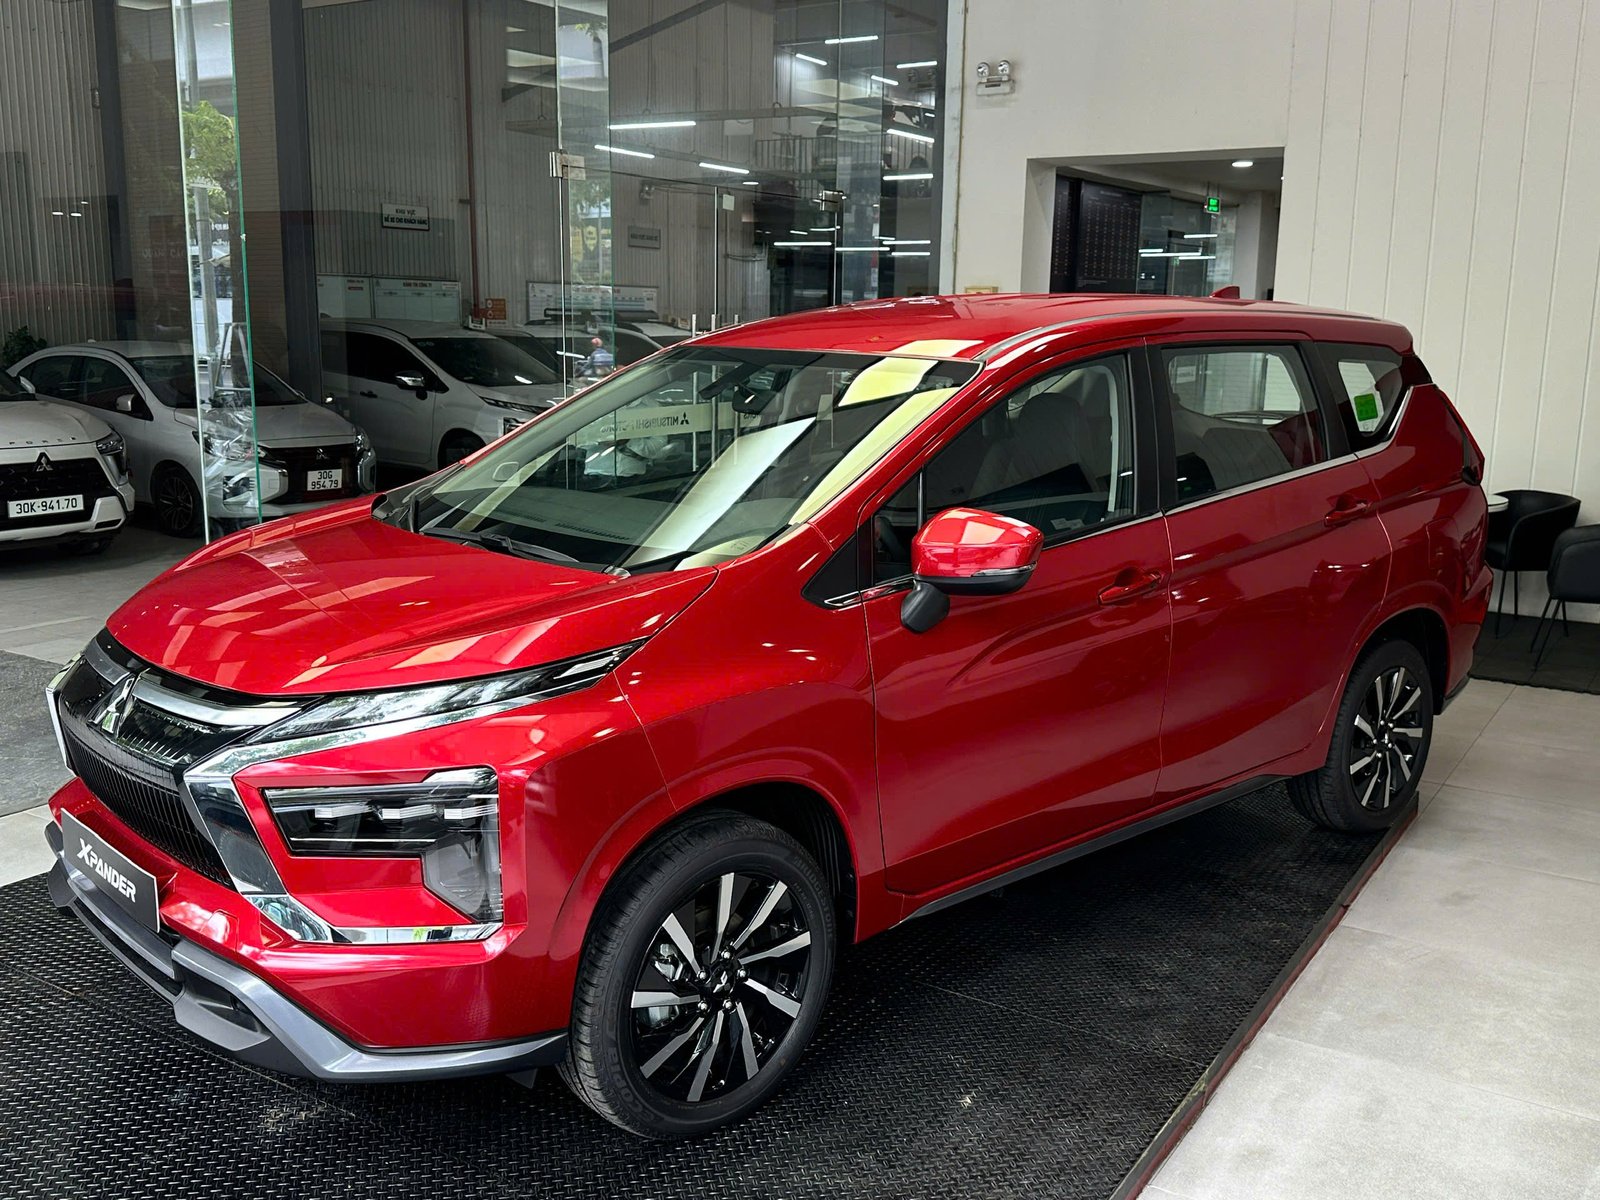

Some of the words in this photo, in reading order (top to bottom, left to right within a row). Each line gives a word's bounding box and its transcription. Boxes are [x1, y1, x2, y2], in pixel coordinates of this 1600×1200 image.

[317, 470, 333, 480] 30G
[311, 479, 339, 490] 954.79
[76, 837, 137, 903] XPANDER
